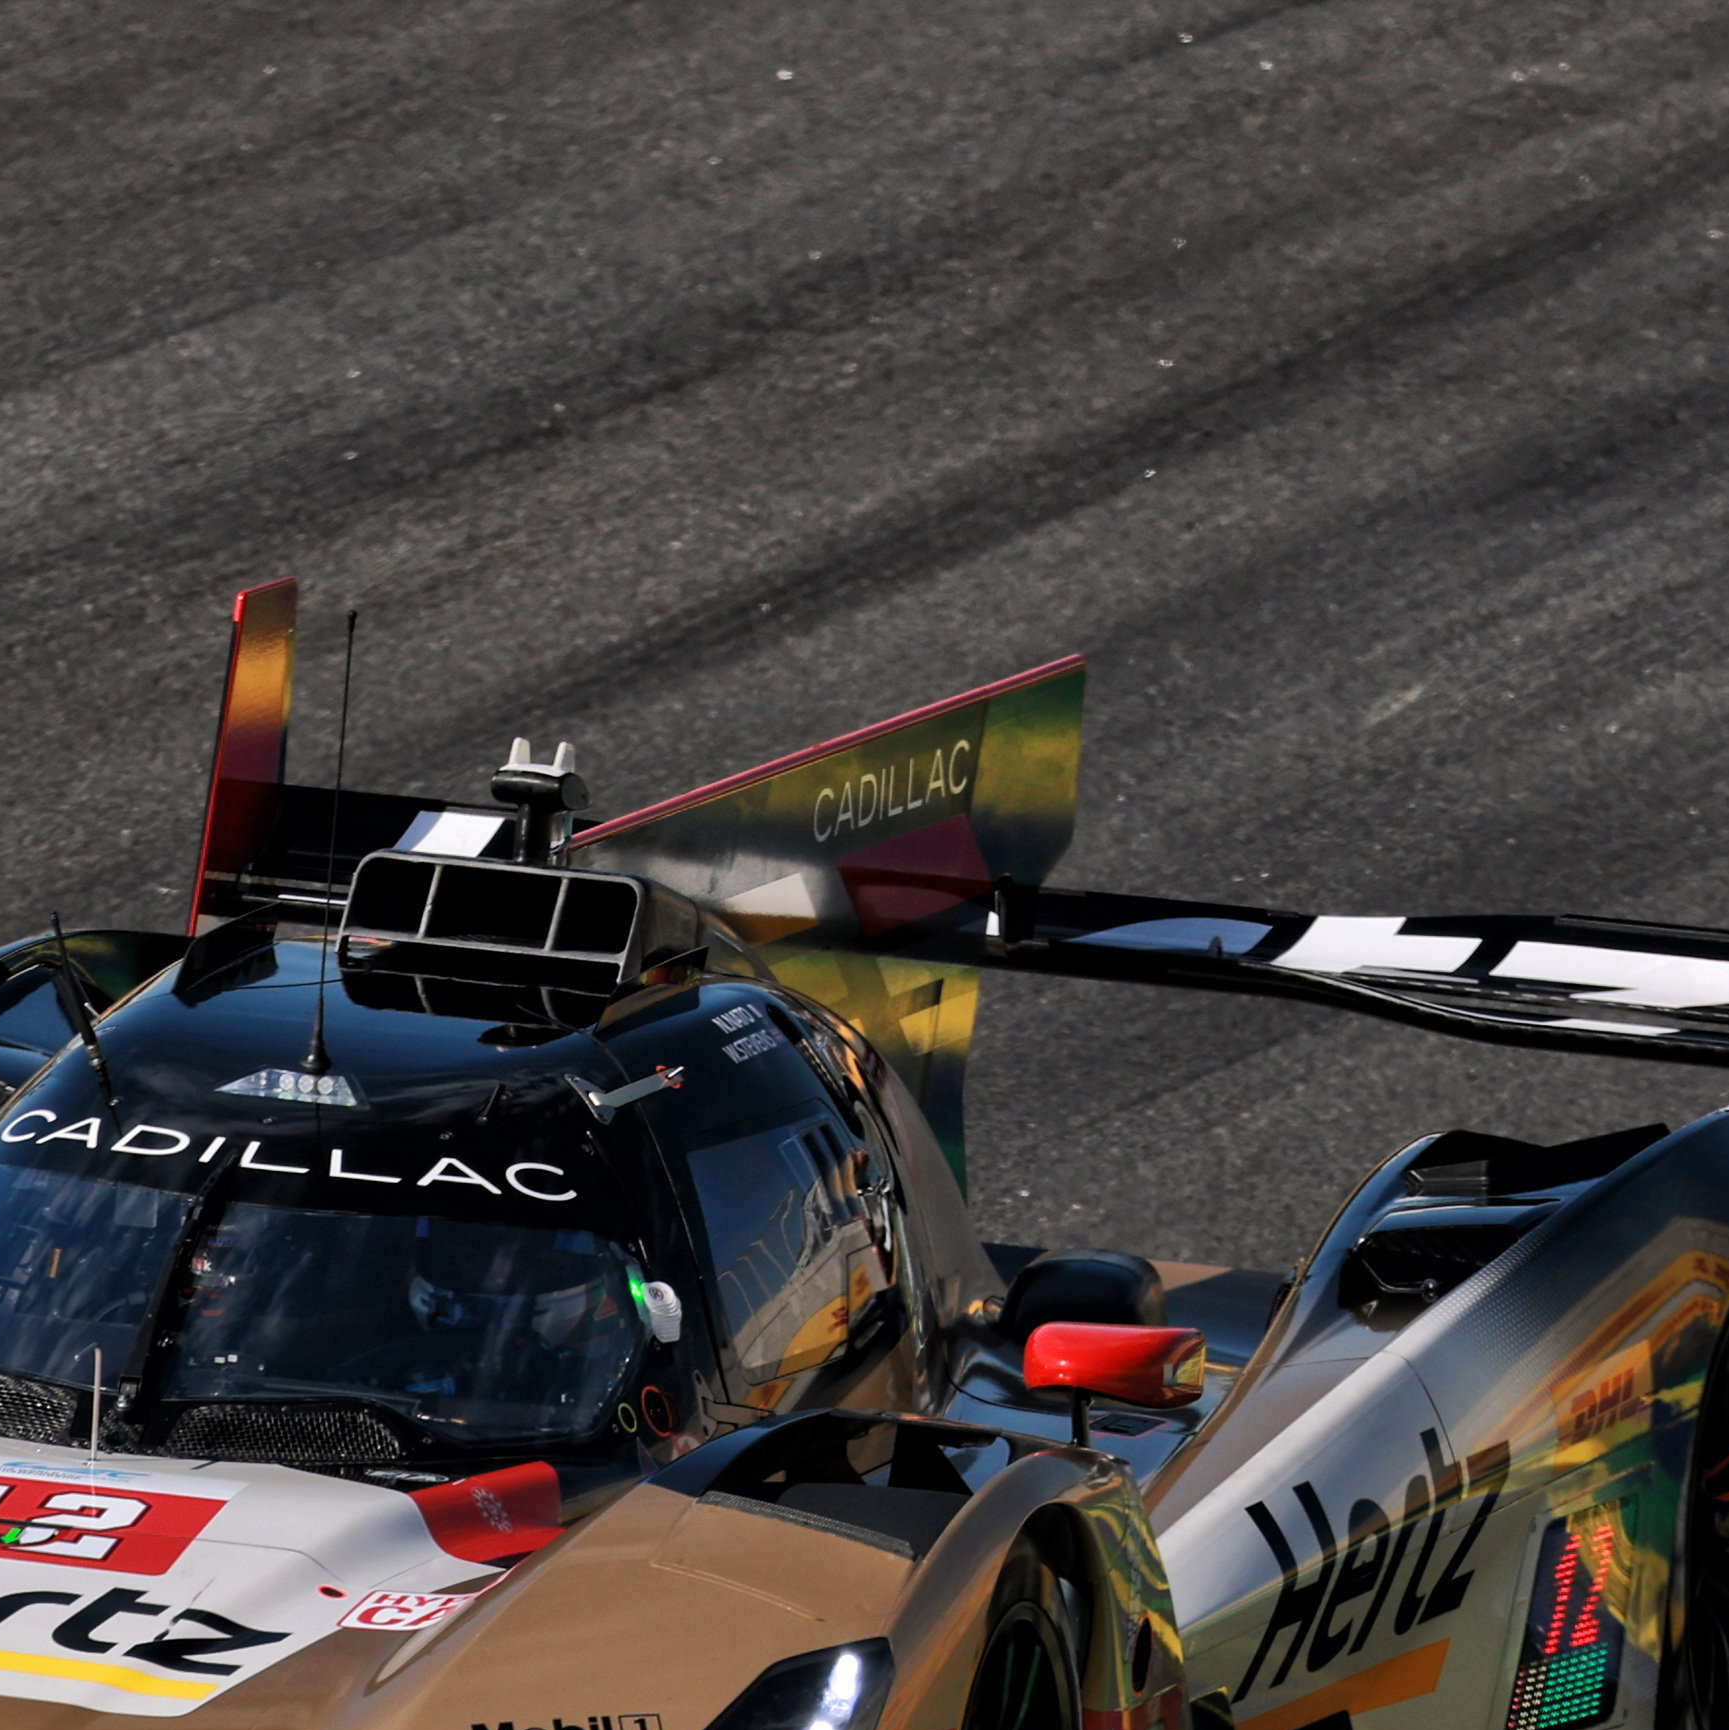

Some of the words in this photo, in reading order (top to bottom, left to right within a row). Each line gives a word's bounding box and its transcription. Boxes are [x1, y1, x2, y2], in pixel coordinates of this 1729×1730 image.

[813, 739, 970, 842] CADILLAC
[0, 1109, 578, 1202] CADILLAC
[1571, 1366, 1644, 1443] DHL
[1231, 1428, 1511, 1704] Hertz
[358, 1606, 455, 1626] CA
